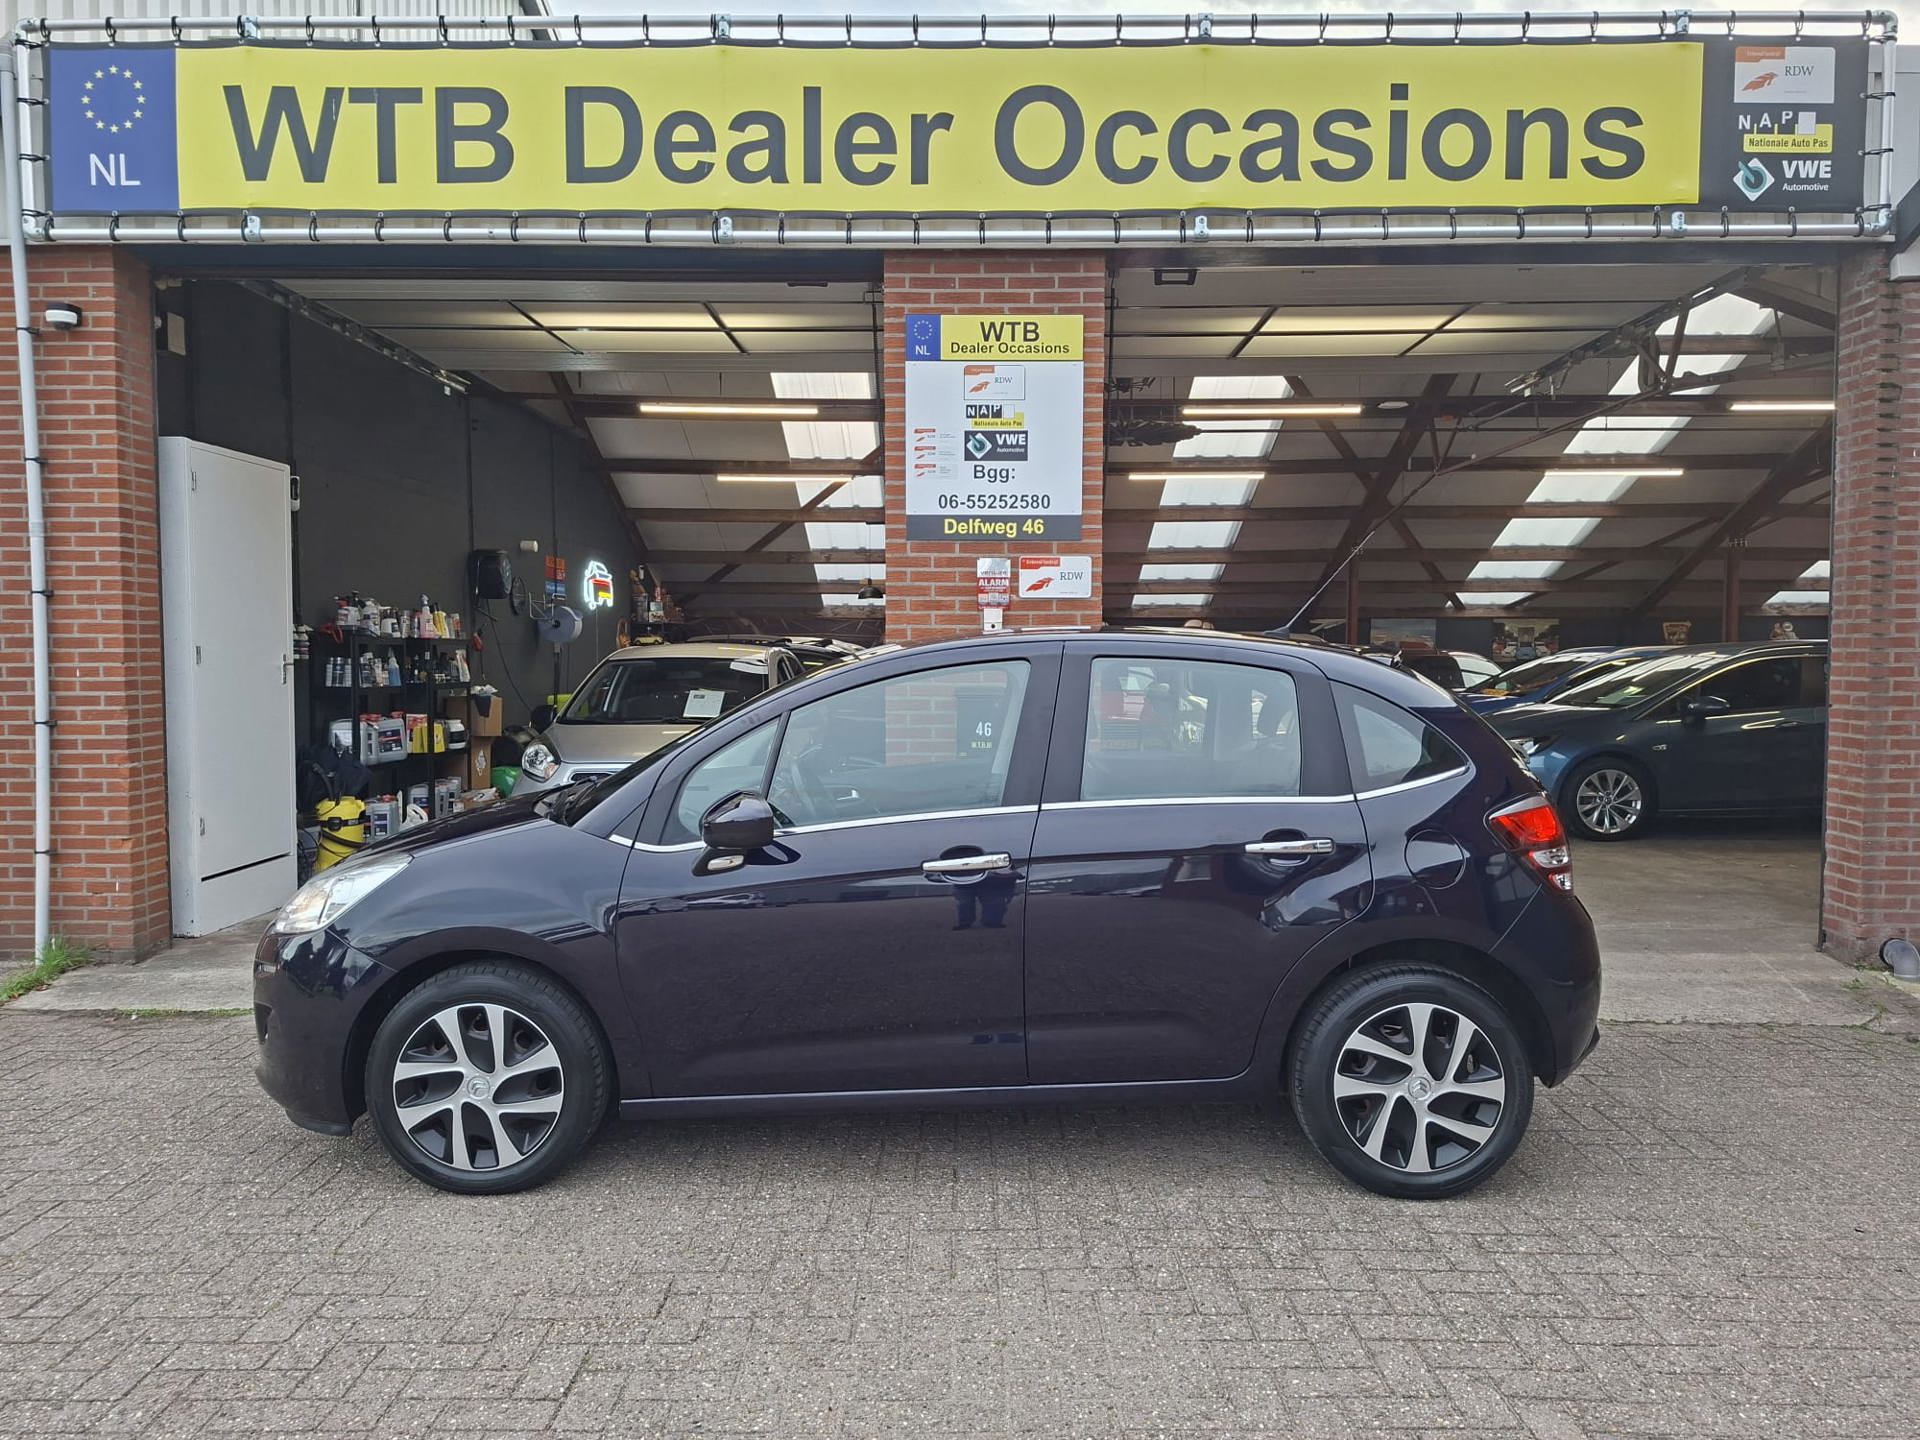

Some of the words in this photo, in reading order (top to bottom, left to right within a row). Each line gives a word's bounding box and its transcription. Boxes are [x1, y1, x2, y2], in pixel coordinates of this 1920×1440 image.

[1784, 65, 1815, 77] RDW
[222, 85, 514, 184] WTB
[564, 85, 956, 186] Dealer
[994, 83, 1646, 186] Occasions
[1748, 138, 1789, 148] Nationale
[1791, 138, 1811, 148] Auto
[1813, 138, 1829, 148] Pas
[88, 153, 142, 187] NL
[1782, 160, 1832, 179] VWE
[1782, 183, 1829, 191] Automotive
[980, 321, 1040, 342] WTB
[915, 344, 931, 356] NL
[950, 342, 995, 354] Dealer
[998, 342, 1070, 354] Occasions
[996, 434, 1026, 446] VWE
[973, 464, 1016, 483] Bgg:
[938, 494, 1051, 510] 06-55252580
[943, 518, 1018, 537] Delfweg
[1022, 518, 1044, 534] 46
[978, 578, 1009, 587] ALARM
[1060, 571, 1084, 581] RDW
[976, 721, 992, 737] 46
